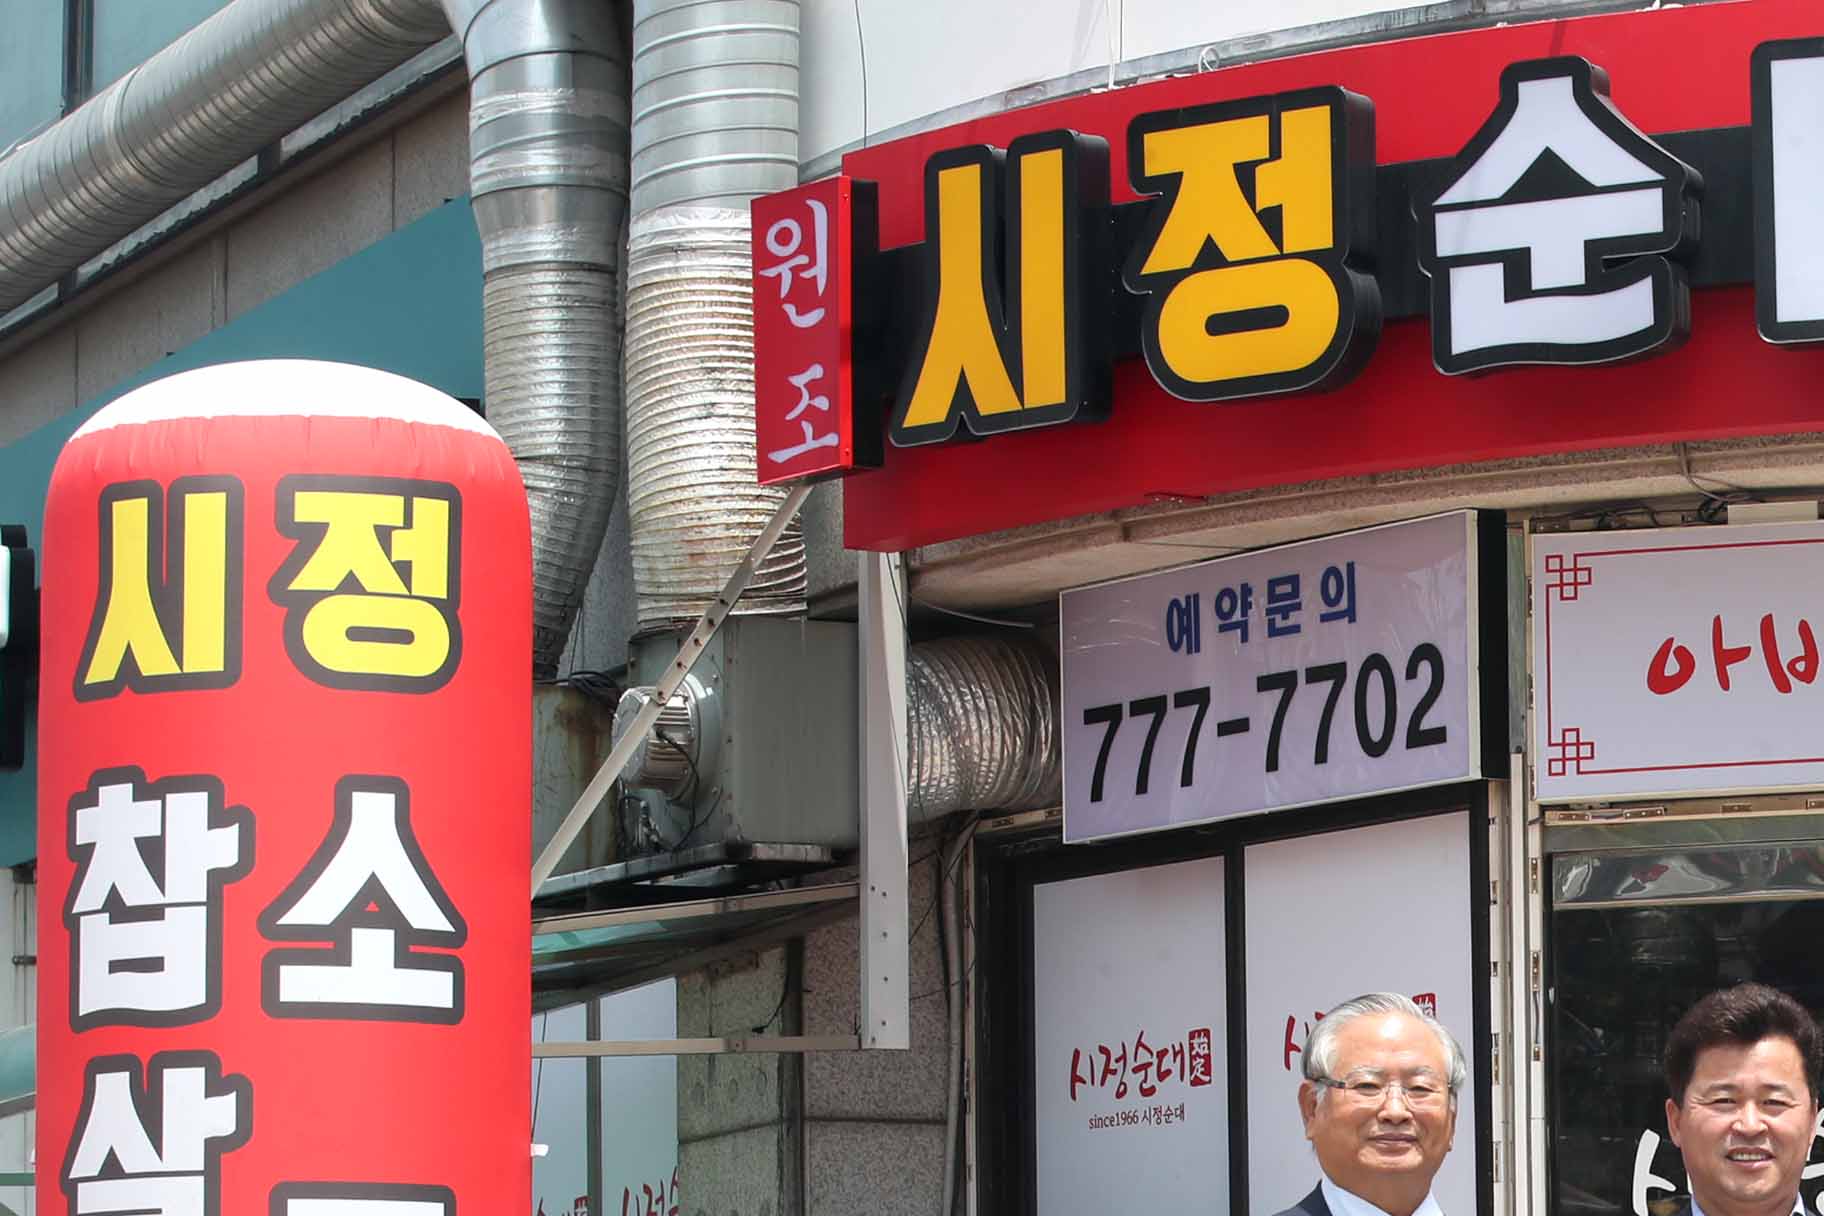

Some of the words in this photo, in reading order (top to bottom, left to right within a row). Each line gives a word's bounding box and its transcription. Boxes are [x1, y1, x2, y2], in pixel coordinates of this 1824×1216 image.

[757, 198, 839, 464] 원조
[83, 488, 452, 687] 시정
[1165, 560, 1358, 655] 예약문의
[1083, 642, 1448, 803] 777-7702
[1070, 1029, 1185, 1102] 시정순대
[1088, 1109, 1139, 1130] since1966
[1141, 1102, 1185, 1127] 시정순대
